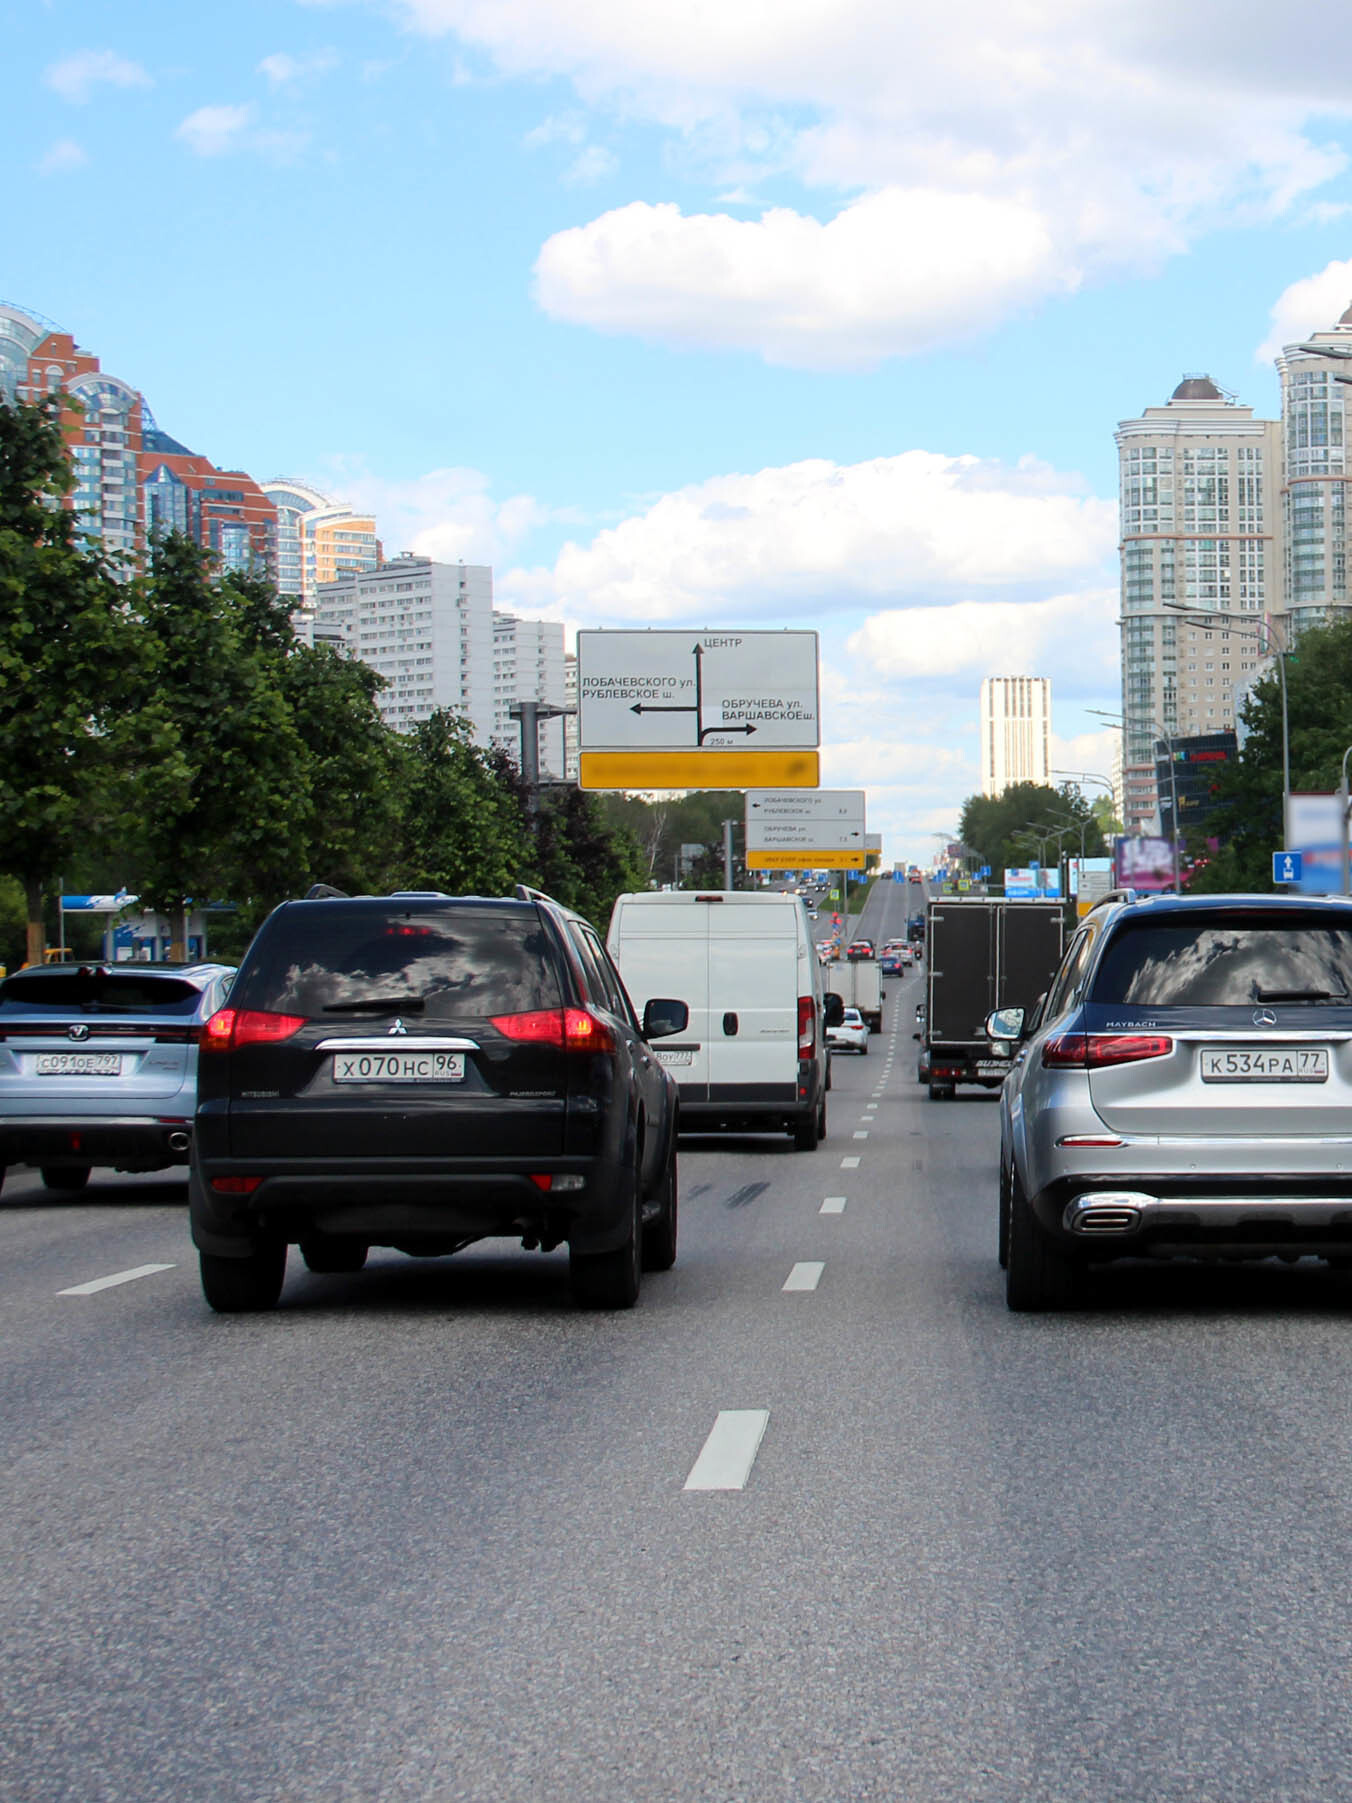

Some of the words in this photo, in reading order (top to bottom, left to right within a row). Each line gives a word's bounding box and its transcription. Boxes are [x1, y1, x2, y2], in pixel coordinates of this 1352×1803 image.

[704, 638, 742, 648] ЦЕНТР
[582, 677, 677, 687] ЛОБАЧЕВСКОГО
[680, 679, 696, 688] ул.
[582, 689, 660, 699] РУБЛЕВСКОЕ
[663, 690, 675, 699] ш.
[722, 699, 784, 709] ОБРУЧЕВА
[786, 700, 803, 710] ул.
